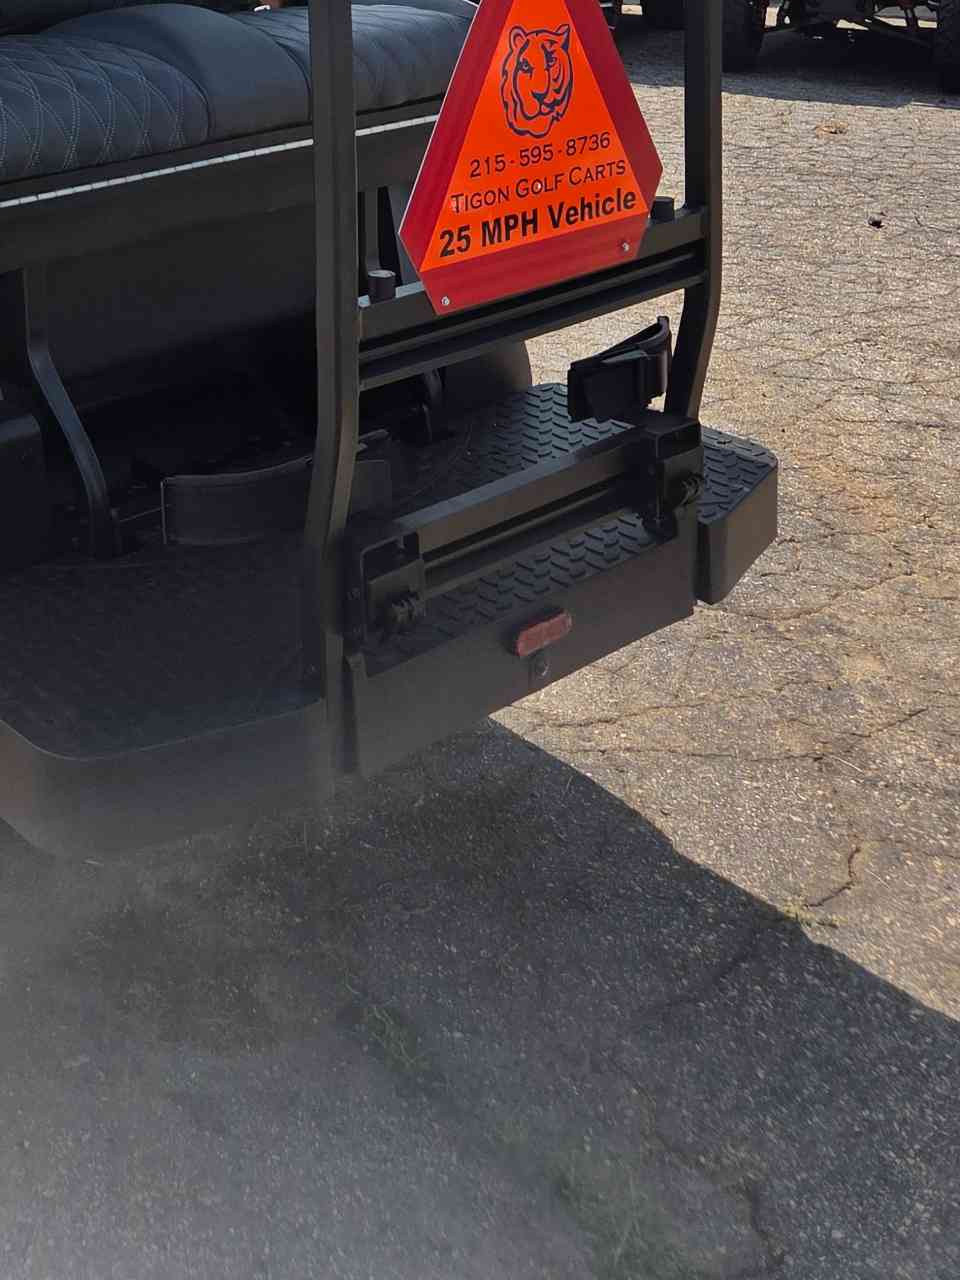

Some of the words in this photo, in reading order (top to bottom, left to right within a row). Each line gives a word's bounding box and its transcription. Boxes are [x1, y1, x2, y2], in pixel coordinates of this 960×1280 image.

[450, 187, 509, 213] TIGON
[516, 173, 564, 198] GOLF
[568, 160, 626, 186] CARTS
[440, 230, 471, 258] 25
[482, 207, 538, 246] MPH
[548, 187, 637, 229] Vehicle
